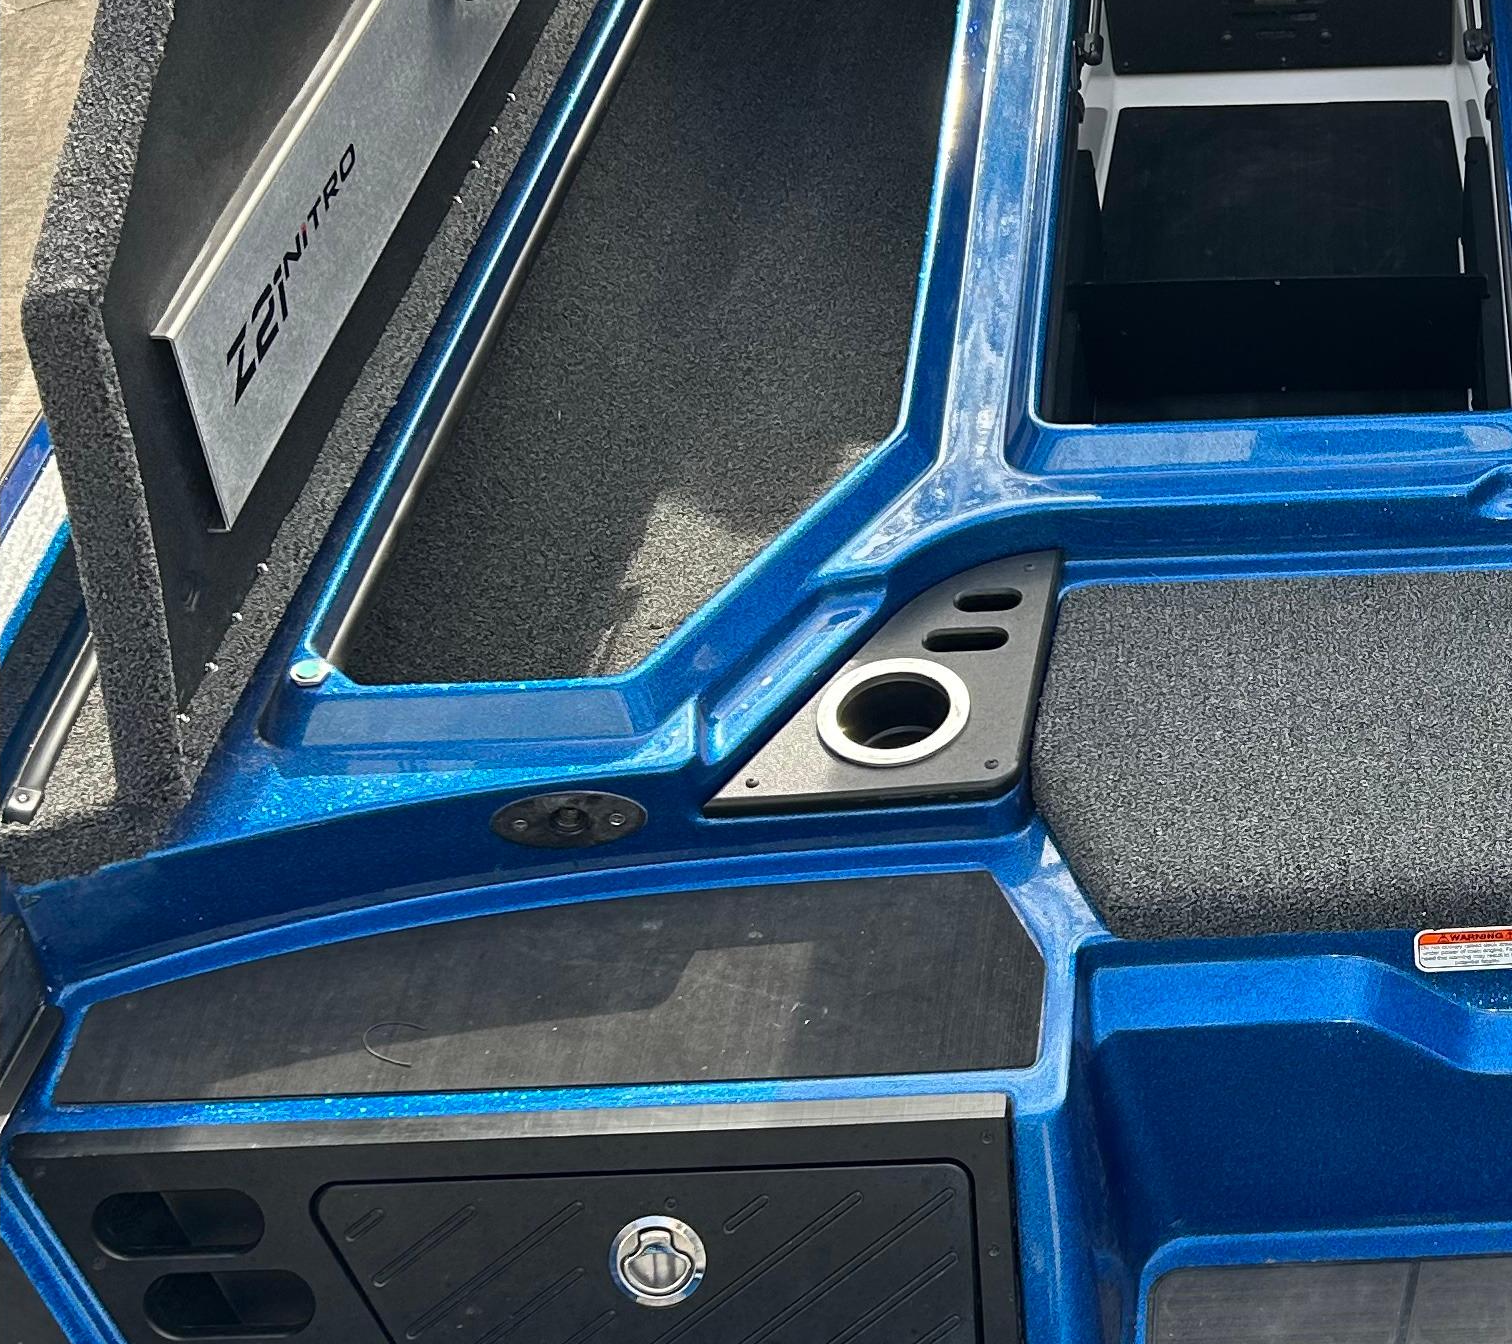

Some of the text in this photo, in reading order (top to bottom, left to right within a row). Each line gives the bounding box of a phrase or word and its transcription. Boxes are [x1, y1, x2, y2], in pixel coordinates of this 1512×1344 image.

[226, 143, 356, 406] Z21 NITRO
[1449, 932, 1504, 942] WARNING
